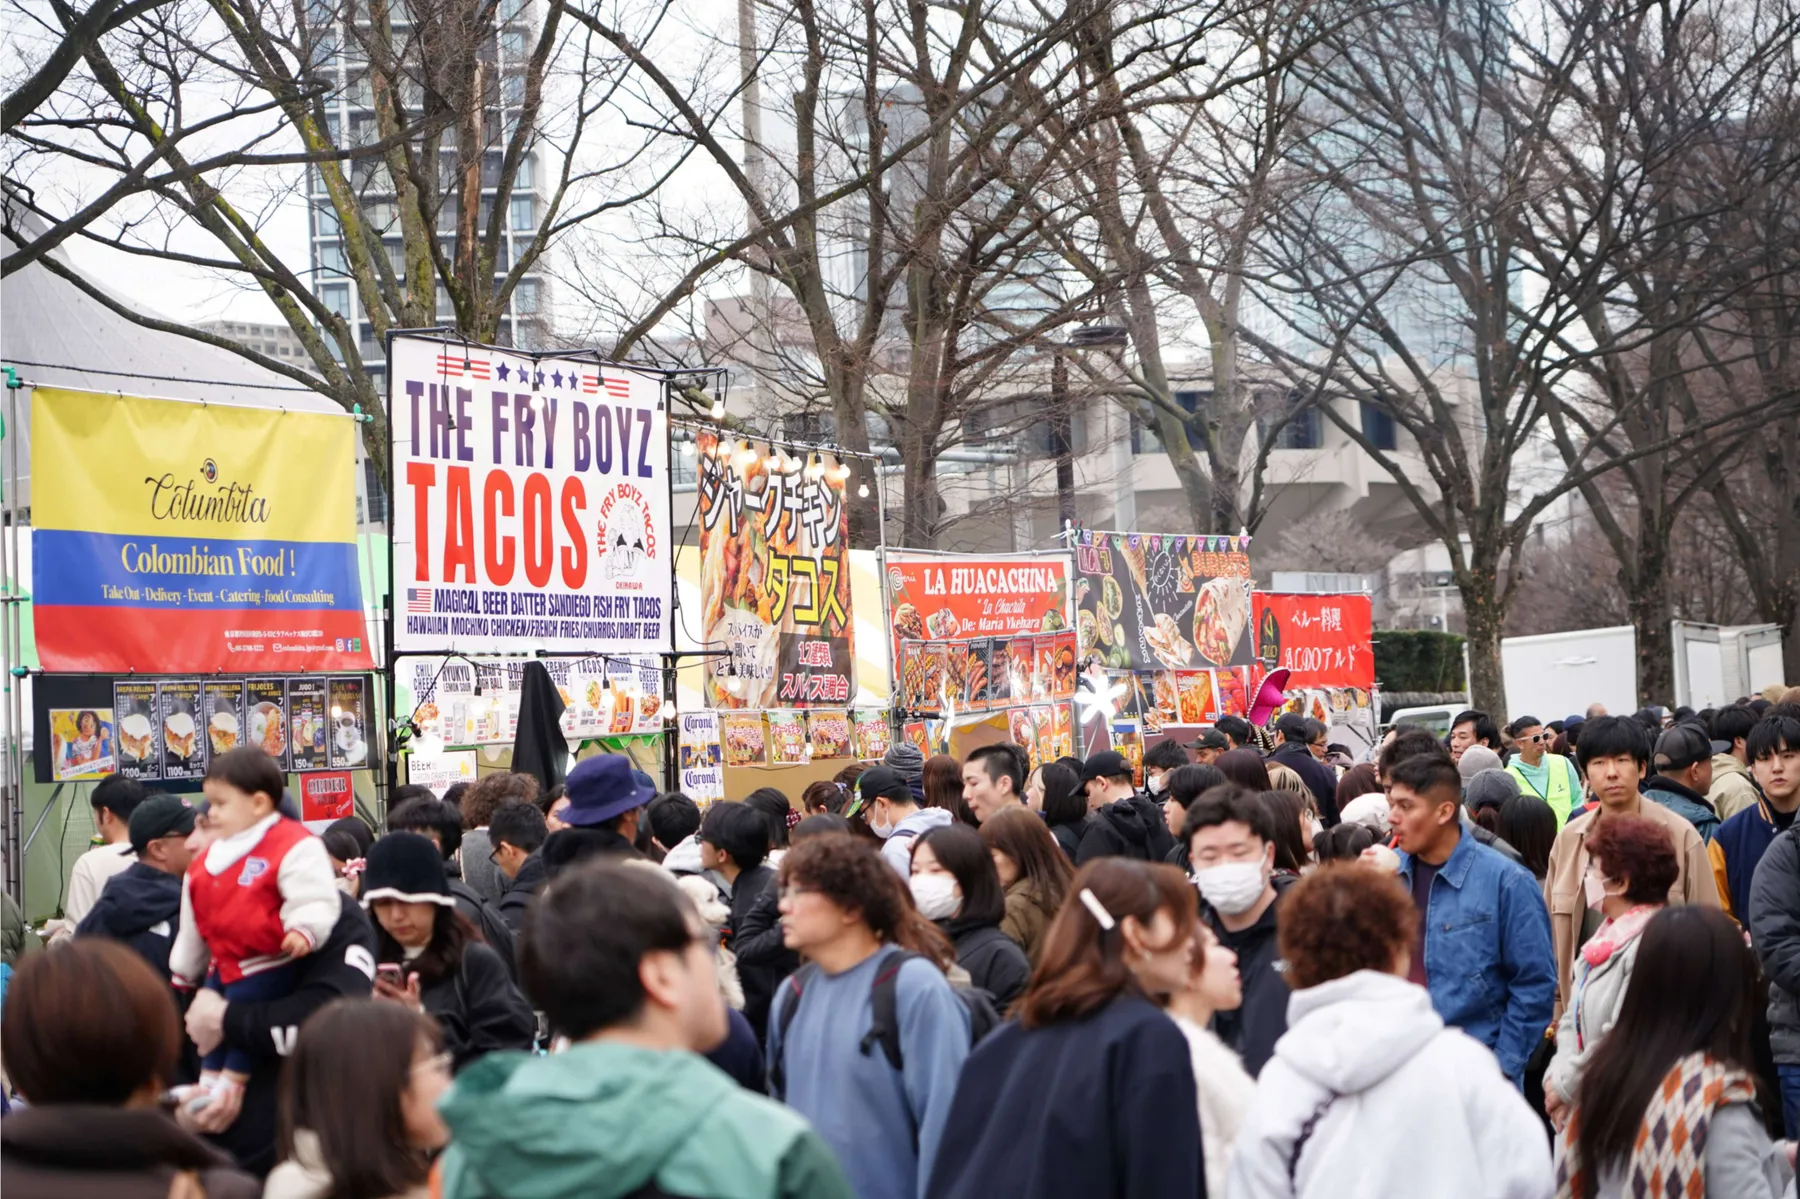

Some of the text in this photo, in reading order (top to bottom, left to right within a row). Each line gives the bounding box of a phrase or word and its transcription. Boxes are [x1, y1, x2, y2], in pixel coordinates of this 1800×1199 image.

[406, 380, 653, 478] THE FRY BOYZ
[145, 473, 271, 523] Columbita
[702, 453, 842, 548] ジャークチキン
[406, 461, 588, 590] TACOS
[597, 483, 656, 560] THE FRY BOYZ TACOS
[121, 542, 235, 576] Colombian
[237, 547, 285, 577] Food
[765, 547, 848, 630] タコス
[924, 567, 1058, 595] LA HUACACHINA
[101, 584, 335, 606] Take Out Delivery Event Catering Food Consulting
[434, 588, 661, 619] MAGICAL BEER BATTER SANDIEGO FISH FRY TACOS
[407, 616, 448, 635] HAWAIIAN
[451, 616, 488, 636] MOCHIKO
[644, 622, 660, 640] BEER
[962, 617, 1040, 632] De: Maria Ykehara
[1291, 607, 1342, 632] ペルー料理
[798, 641, 832, 667] 12種類
[416, 664, 434, 677] CHILI
[577, 659, 602, 674] TACOS
[638, 670, 659, 682] CHEESE
[248, 682, 274, 690] FRIJOLES
[414, 677, 437, 690] CHEESE
[444, 682, 458, 692] LEMON
[780, 673, 850, 700] スパイス調合
[684, 715, 713, 732] Corona
[411, 760, 432, 771] BEER
[308, 778, 346, 794] ORDER
[685, 770, 716, 788] Corona
[238, 856, 270, 886] P
